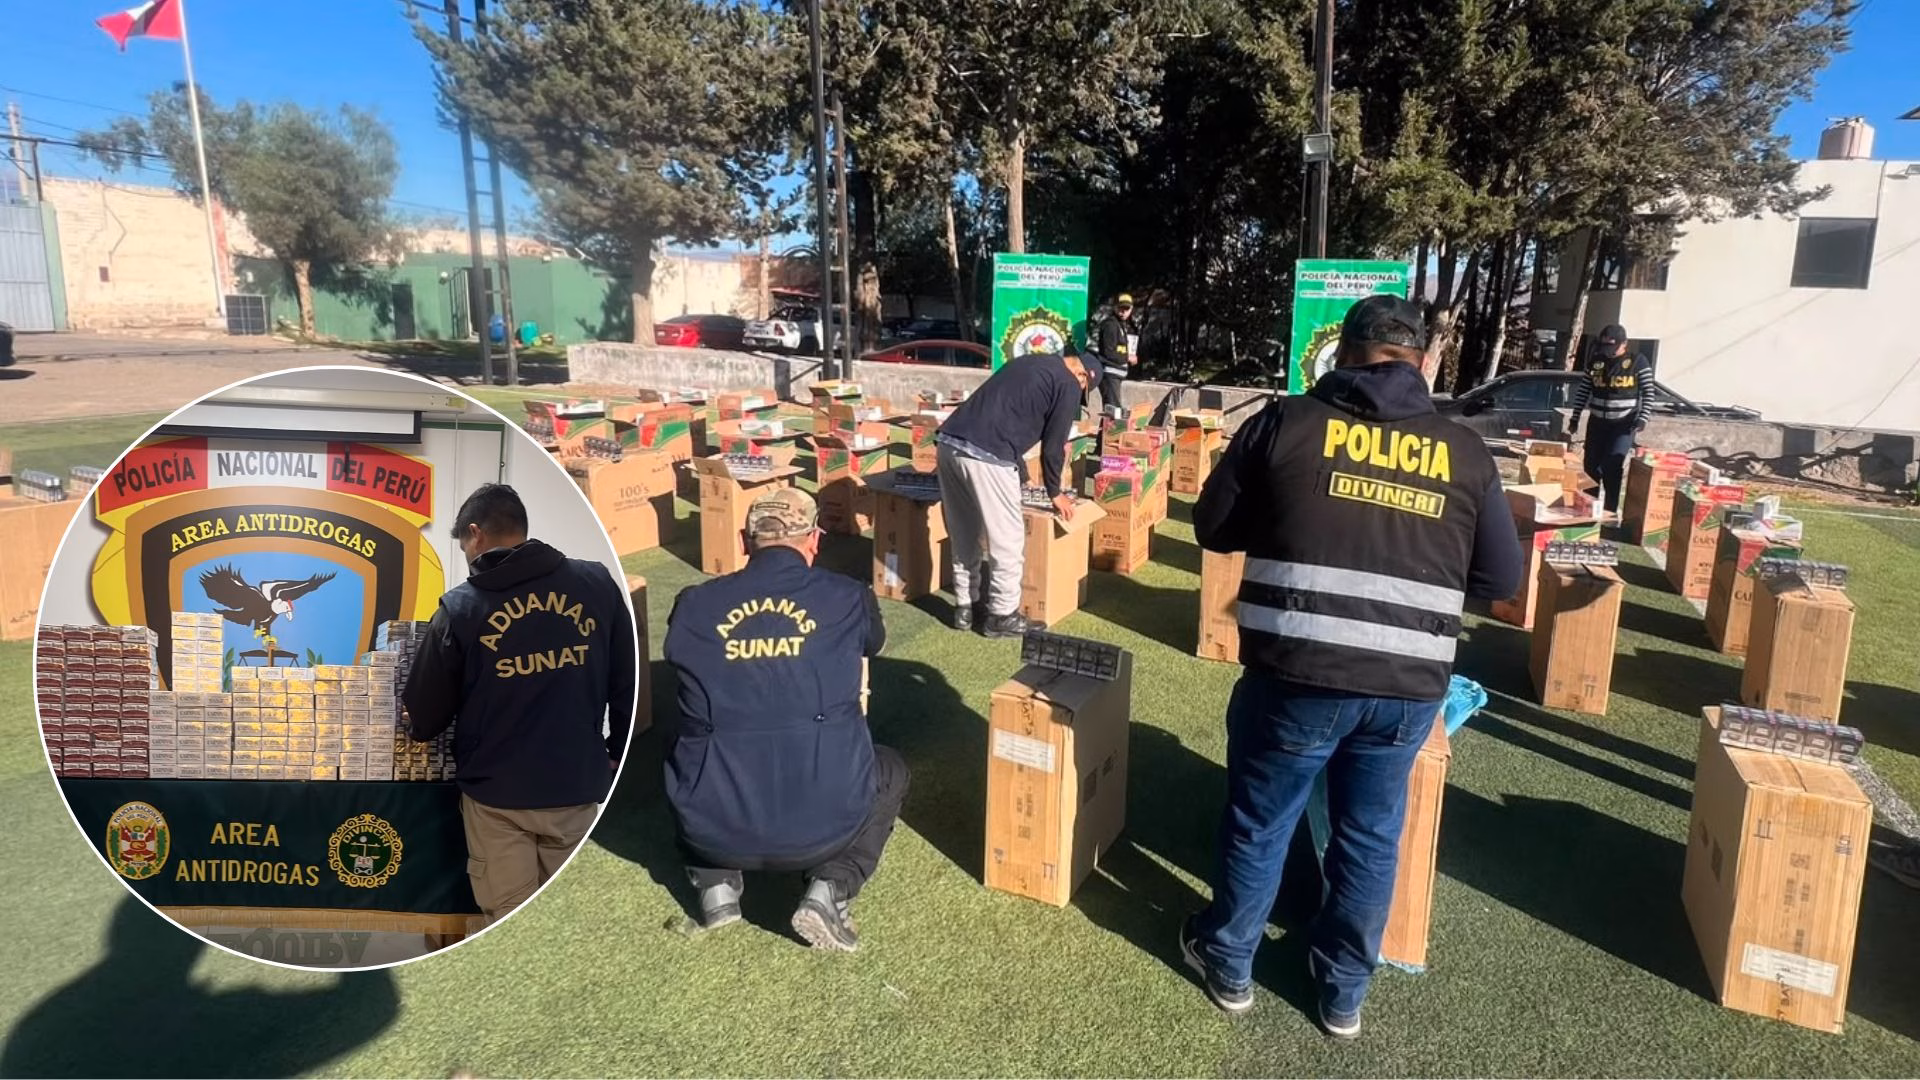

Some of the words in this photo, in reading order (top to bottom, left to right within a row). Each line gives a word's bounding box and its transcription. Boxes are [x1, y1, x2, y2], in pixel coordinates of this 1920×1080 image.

[113, 453, 196, 497] POLICÍA
[216, 452, 318, 479] NACIONAL
[331, 457, 368, 487] DEL
[372, 469, 427, 505] PERÚ
[1336, 477, 1437, 513] DIVINCRI
[170, 518, 230, 553] AREA
[235, 514, 377, 558] ANTIDROGAS
[480, 591, 596, 653] ADUANAS
[716, 597, 817, 639] ADUANAS
[495, 644, 590, 678] SUNAT
[725, 636, 805, 660] SUNAT
[210, 822, 281, 847] AREA
[343, 825, 391, 847] DIVINCRI
[175, 859, 320, 887] ANTIDROGAS
